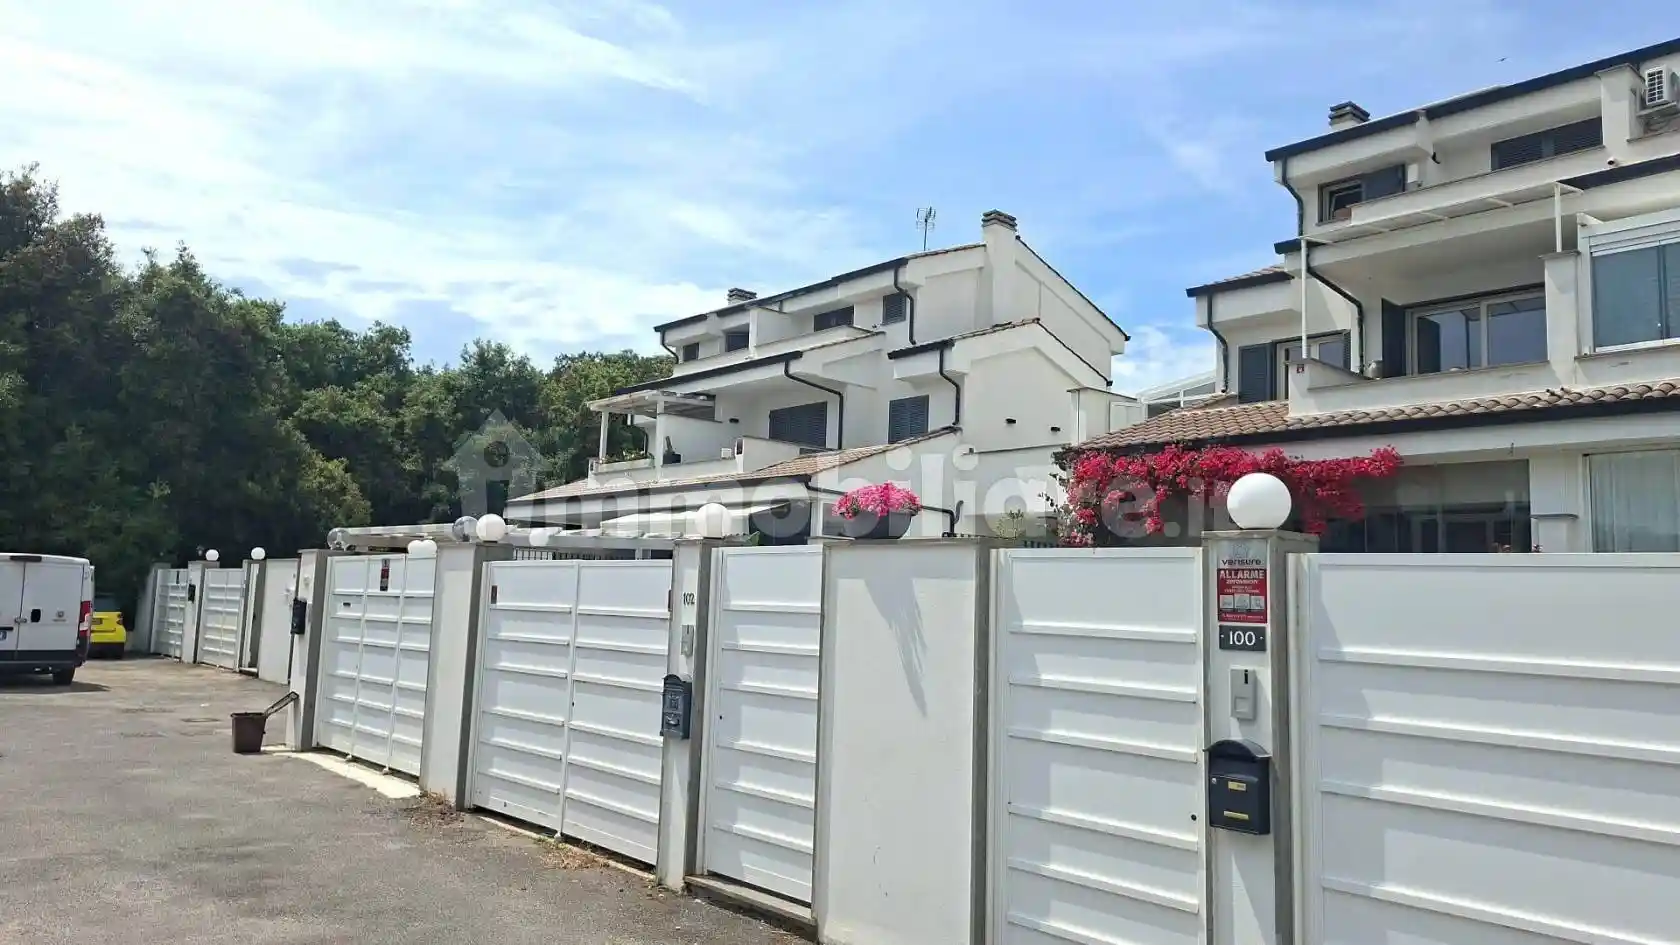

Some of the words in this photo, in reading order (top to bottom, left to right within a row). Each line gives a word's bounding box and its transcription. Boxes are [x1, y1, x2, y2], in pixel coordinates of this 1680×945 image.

[1220, 570, 1265, 579] ALLARME
[683, 592, 695, 605] 102
[1230, 631, 1256, 646] 100
